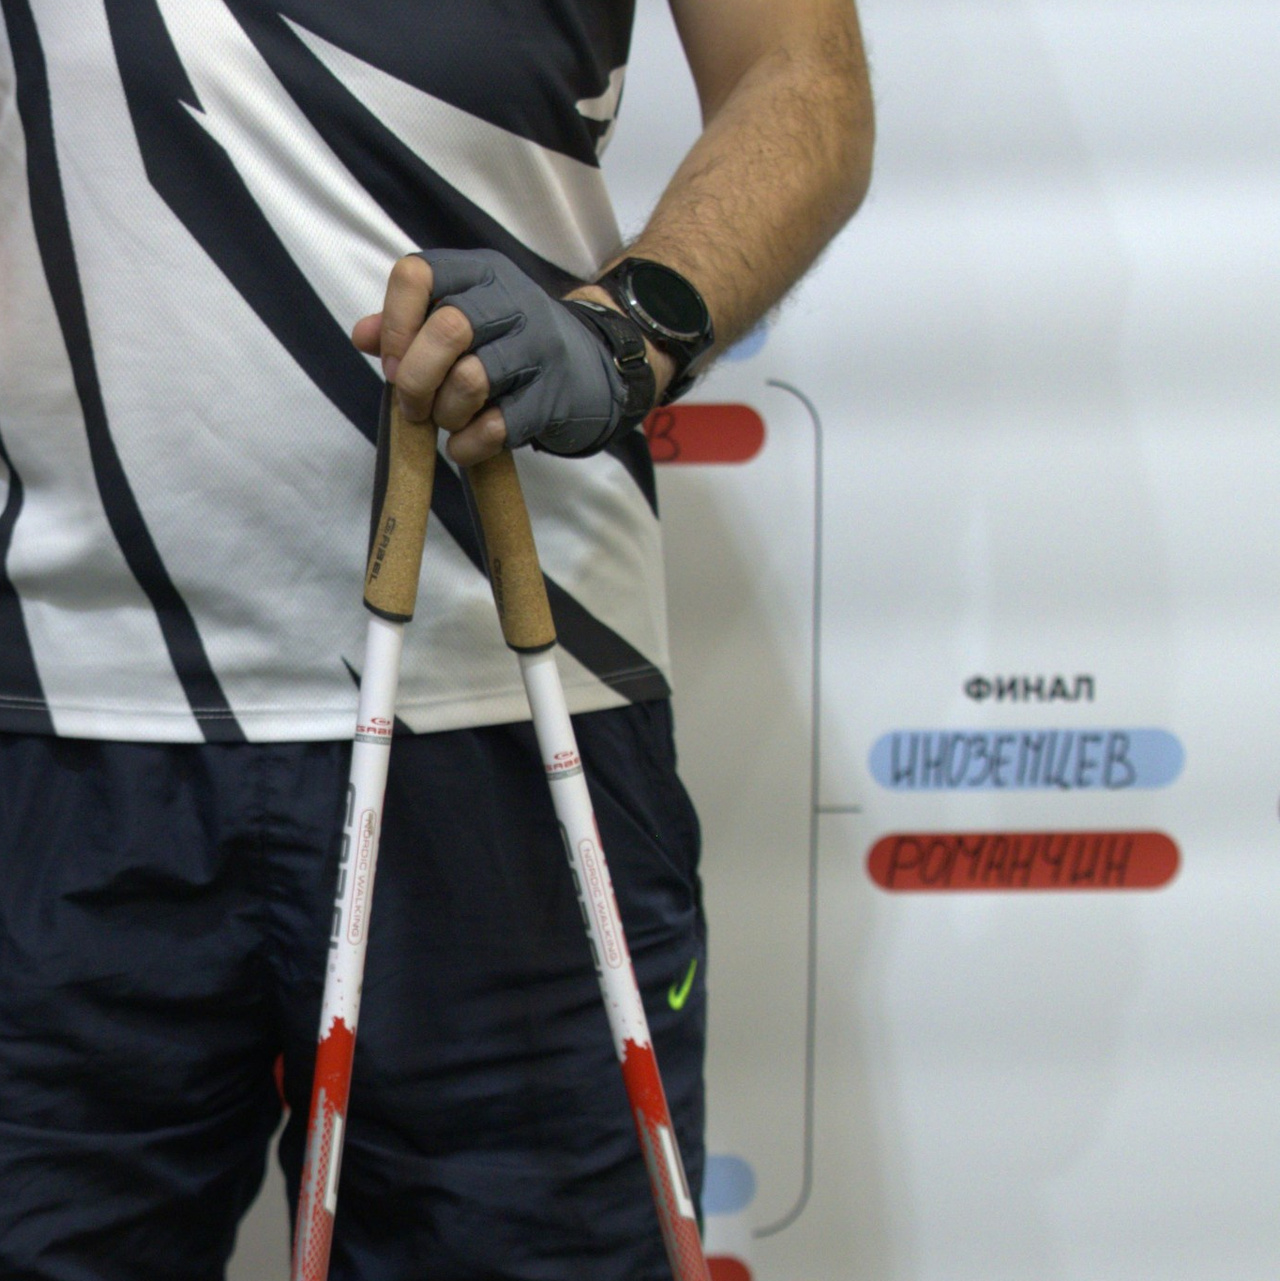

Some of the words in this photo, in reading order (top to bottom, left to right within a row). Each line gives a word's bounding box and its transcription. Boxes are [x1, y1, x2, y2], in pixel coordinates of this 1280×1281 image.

[368, 516, 397, 586] GABEL
[963, 674, 1096, 703] ФИНАЛ
[889, 729, 1137, 791] ИНОЗЕМЦЕВ
[885, 834, 1136, 888] РОМАНЧИН
[350, 874, 367, 938] WALKING
[583, 847, 603, 898] NORDIC
[596, 901, 619, 962] WALKING
